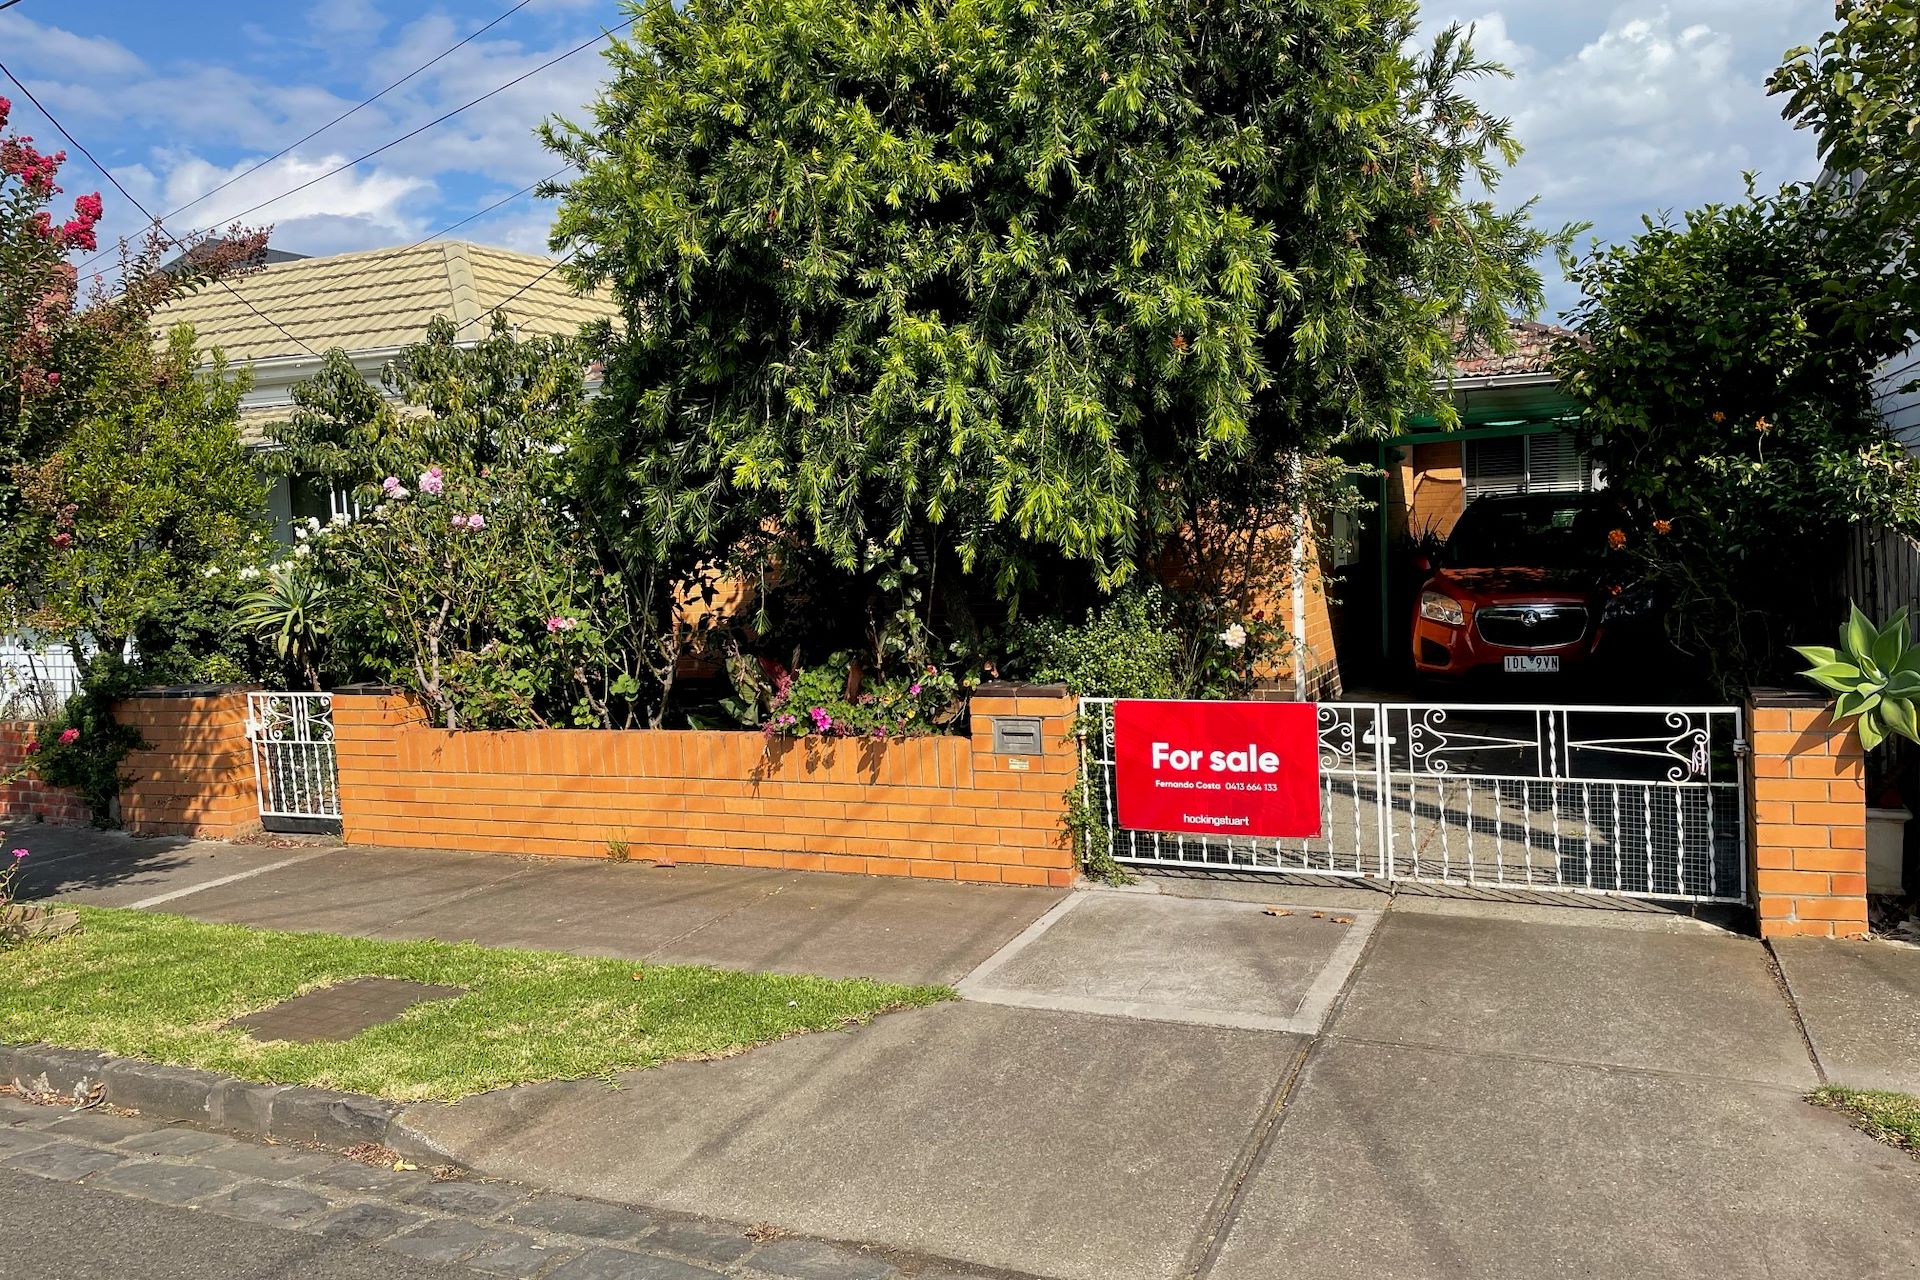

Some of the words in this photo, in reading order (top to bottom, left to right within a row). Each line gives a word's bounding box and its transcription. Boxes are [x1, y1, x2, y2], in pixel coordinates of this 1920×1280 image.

[1506, 657, 1526, 668] 1DL
[1536, 657, 1557, 668] 9VN
[1152, 742, 1203, 771] For
[1209, 744, 1280, 773] sale
[1155, 779, 1195, 790] Fernando
[1195, 780, 1221, 790] Costa
[1225, 782, 1245, 791] 0413
[1246, 782, 1262, 792] 664
[1264, 782, 1278, 792] 133
[1183, 813, 1250, 827] hockingstuart
